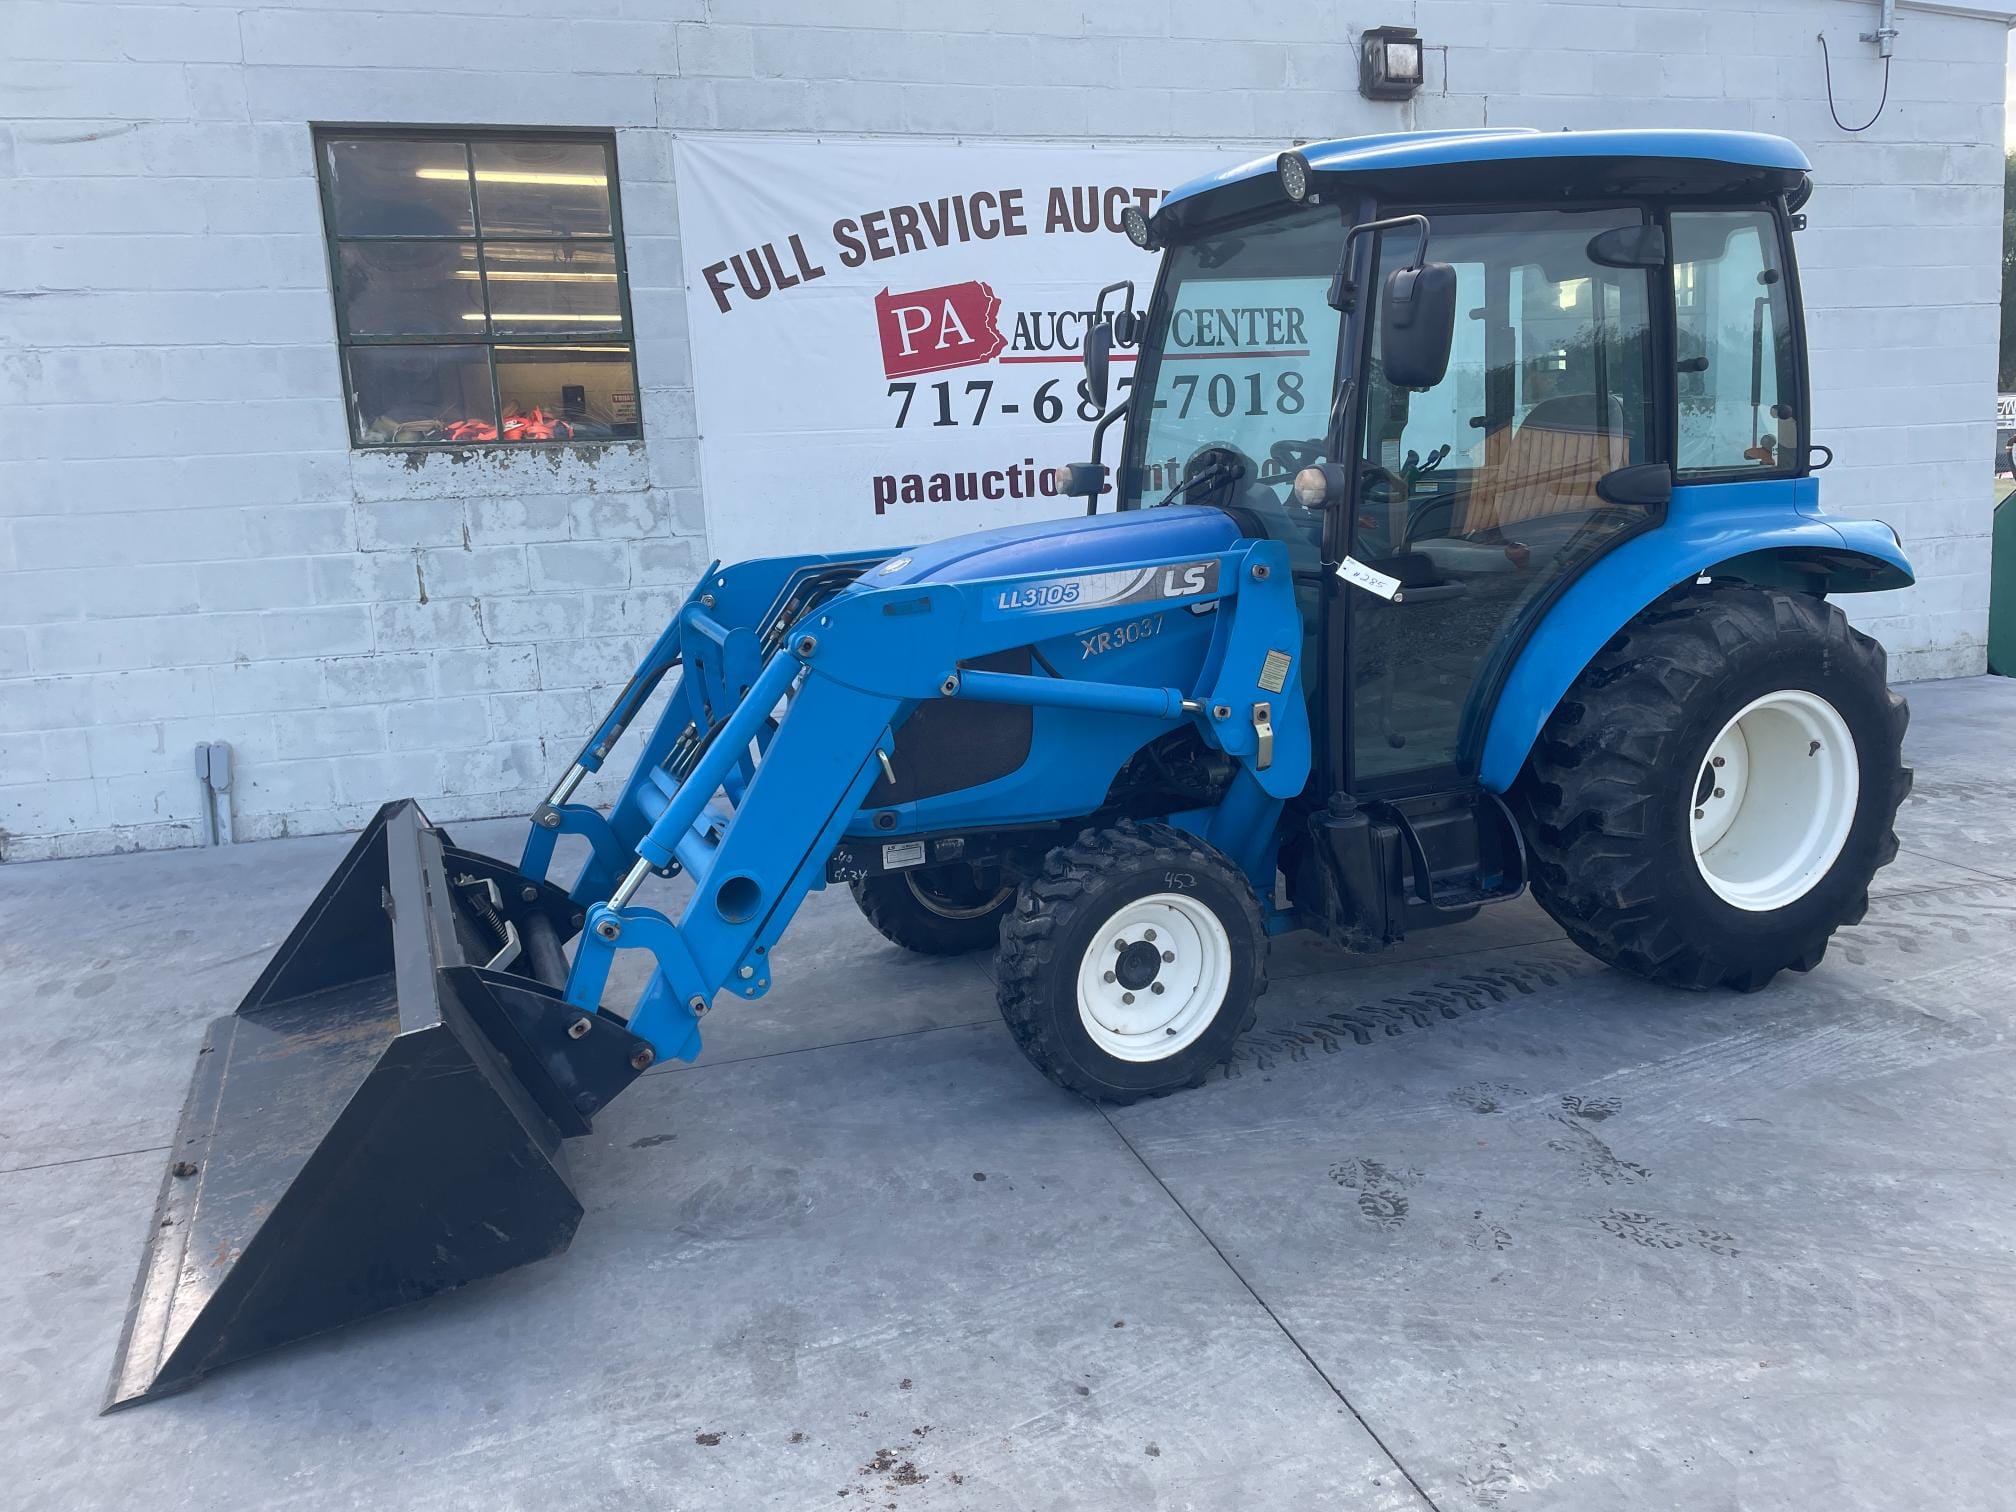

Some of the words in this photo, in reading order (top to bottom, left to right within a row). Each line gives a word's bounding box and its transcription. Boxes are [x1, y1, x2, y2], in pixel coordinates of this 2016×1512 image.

[702, 234, 825, 314] FULL
[833, 188, 1027, 268] SERVICE
[1045, 186, 1171, 234] AUCT
[890, 298, 973, 356] PA
[1172, 307, 1308, 348] CENTER
[998, 584, 1079, 610] LL3105
[1163, 561, 1216, 597] LS
[1081, 614, 1164, 660] XR3037
